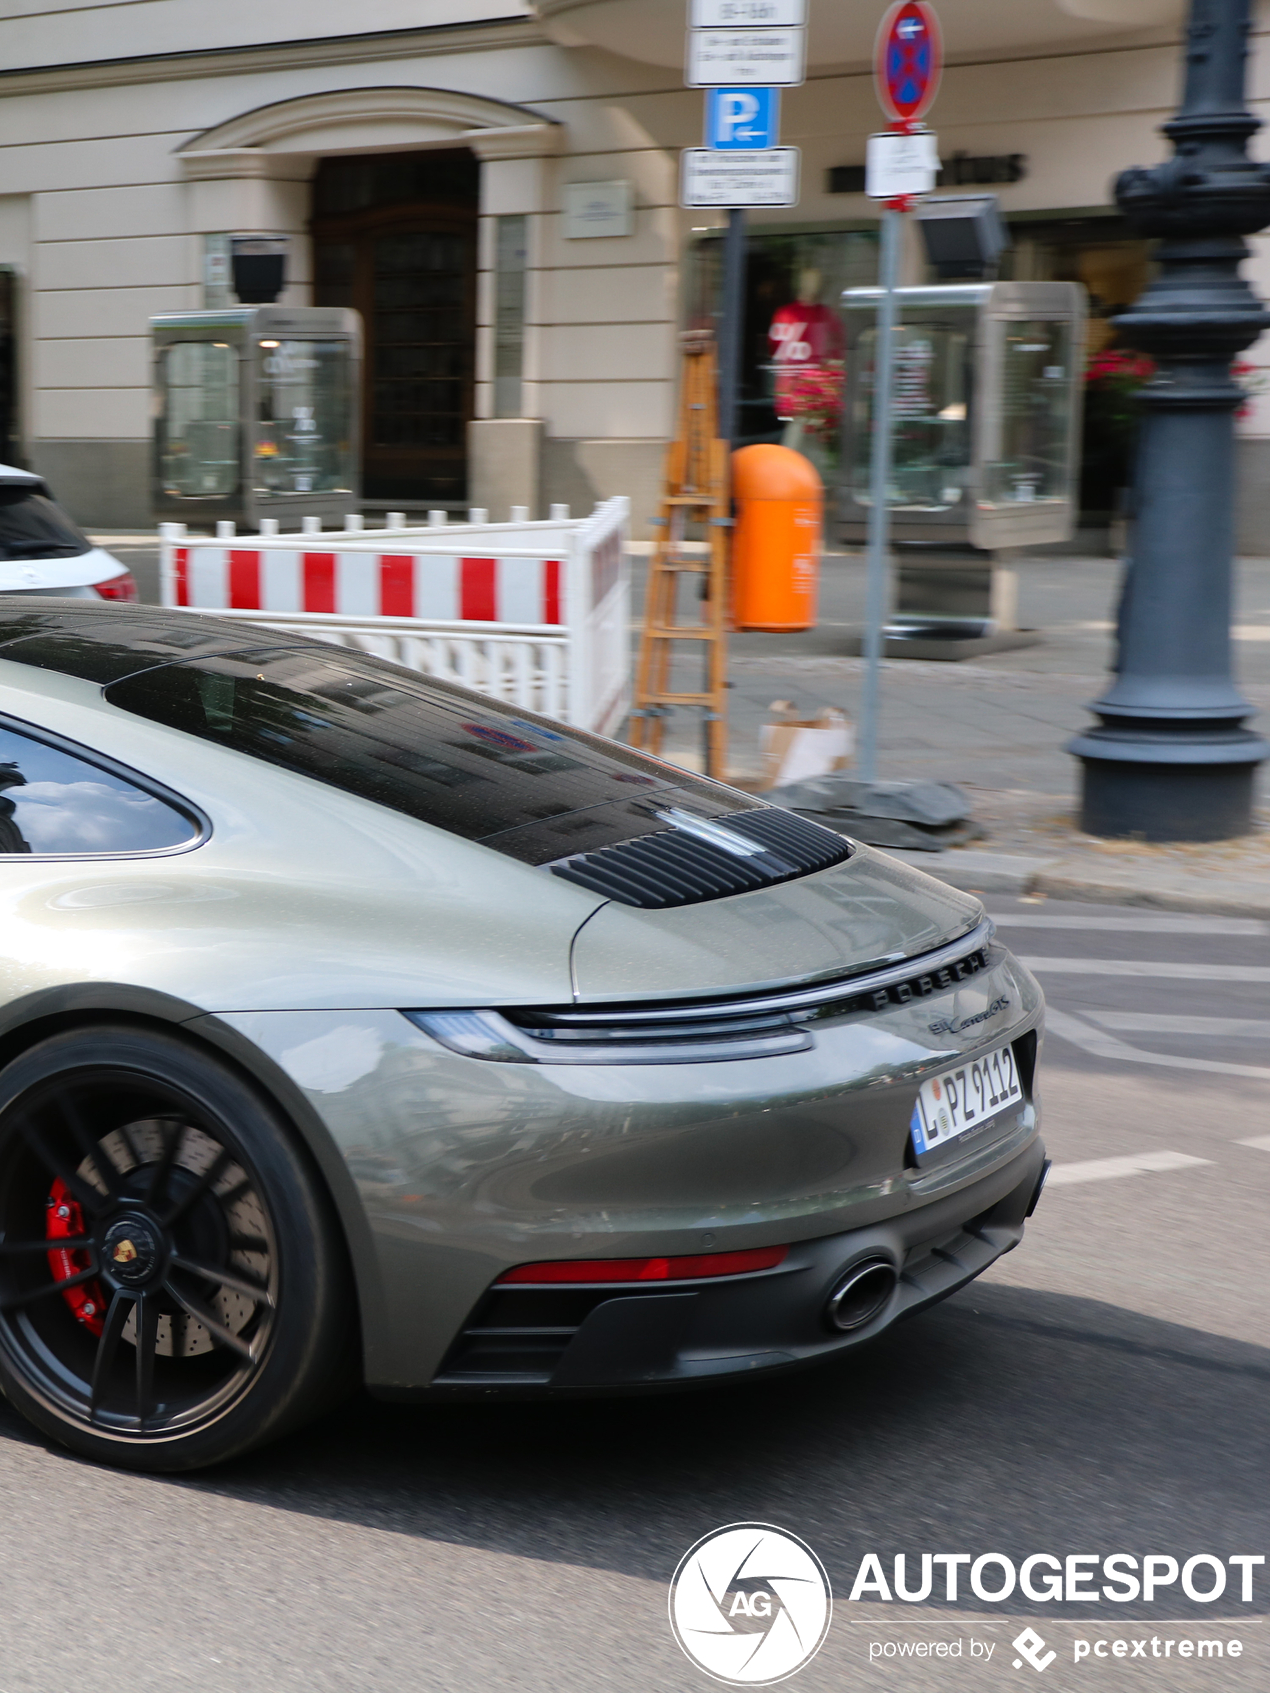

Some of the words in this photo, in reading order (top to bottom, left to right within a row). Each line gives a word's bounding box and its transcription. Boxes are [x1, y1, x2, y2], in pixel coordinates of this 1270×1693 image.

[717, 93, 761, 141] P
[870, 951, 990, 1011] PORSCHE
[919, 1090, 939, 1140] L
[943, 1069, 976, 1127] PZ
[971, 1047, 1019, 1113] 9112
